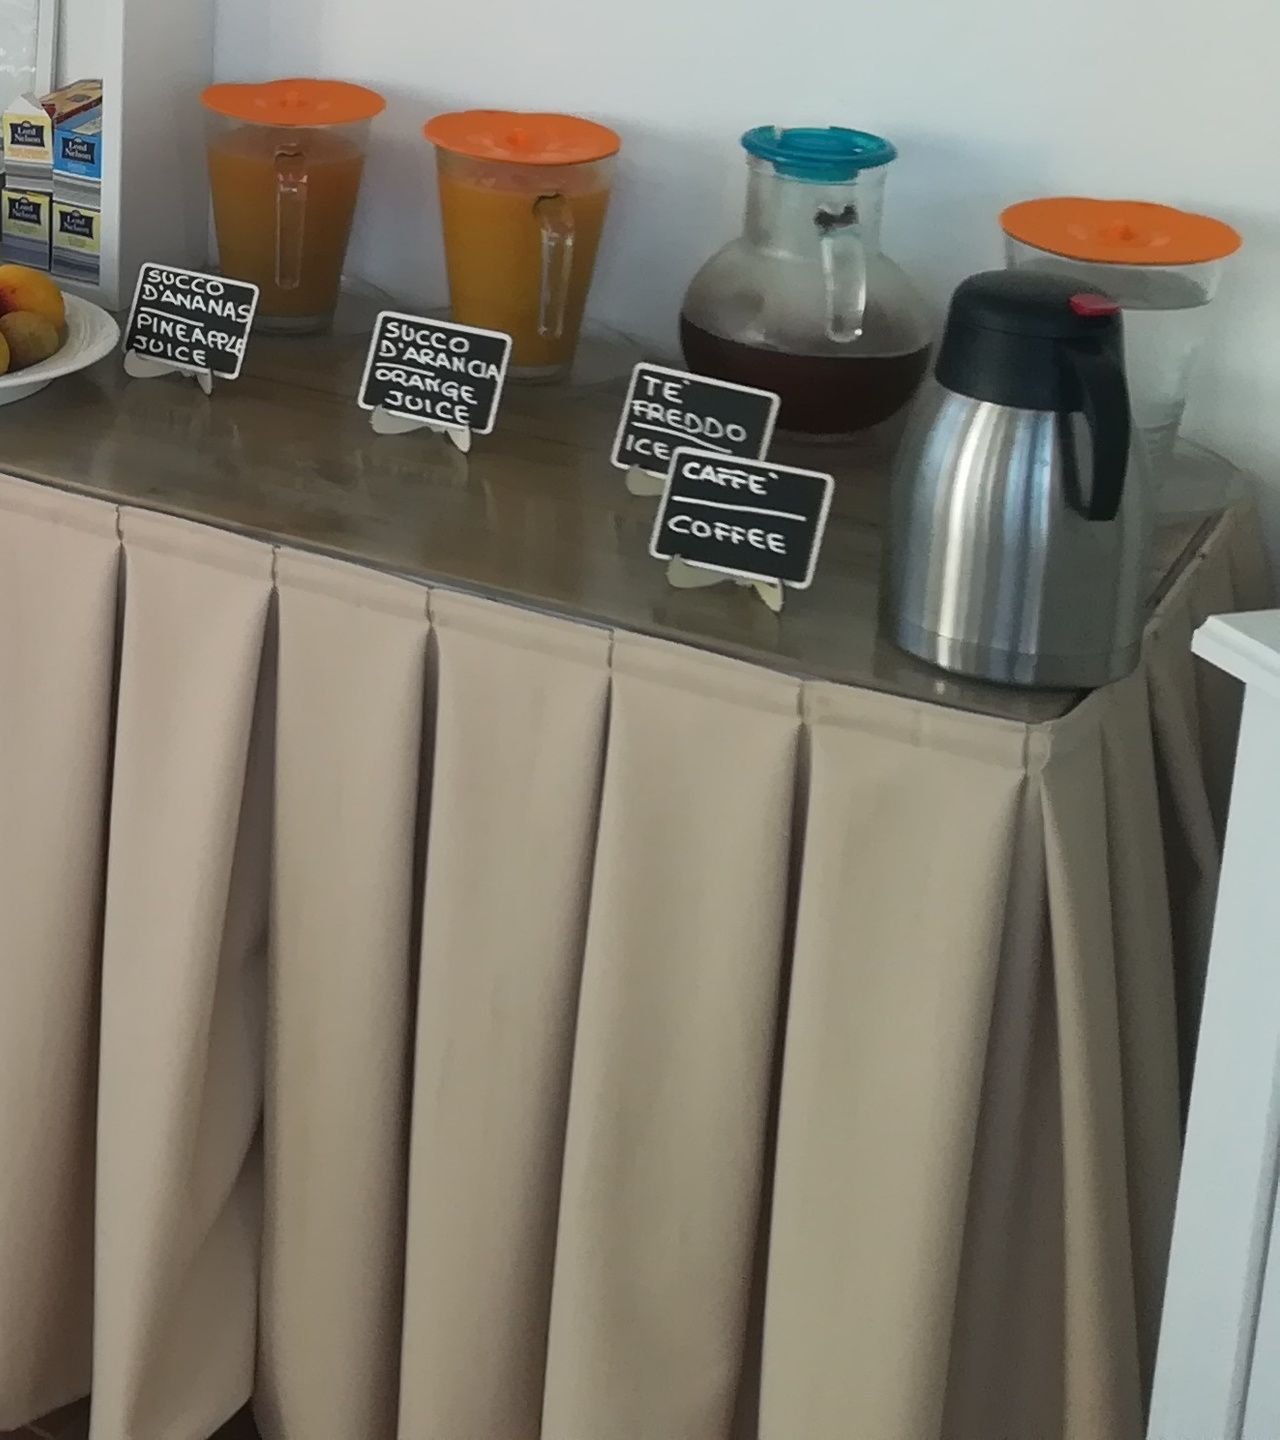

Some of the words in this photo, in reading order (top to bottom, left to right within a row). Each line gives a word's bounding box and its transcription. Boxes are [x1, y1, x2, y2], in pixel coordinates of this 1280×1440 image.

[147, 269, 225, 296] SUCCO
[142, 284, 252, 323] D'ANANAS
[132, 335, 207, 366] JUICE
[137, 313, 246, 357] PINEAPPLE
[384, 322, 470, 353] SUCCO
[378, 339, 499, 381] D'ARANCIA
[375, 369, 478, 405] ORANGE
[384, 390, 470, 425] JUICE
[631, 399, 747, 442] FREDDO
[625, 434, 671, 460] ICE
[667, 515, 788, 555] COFFEE
